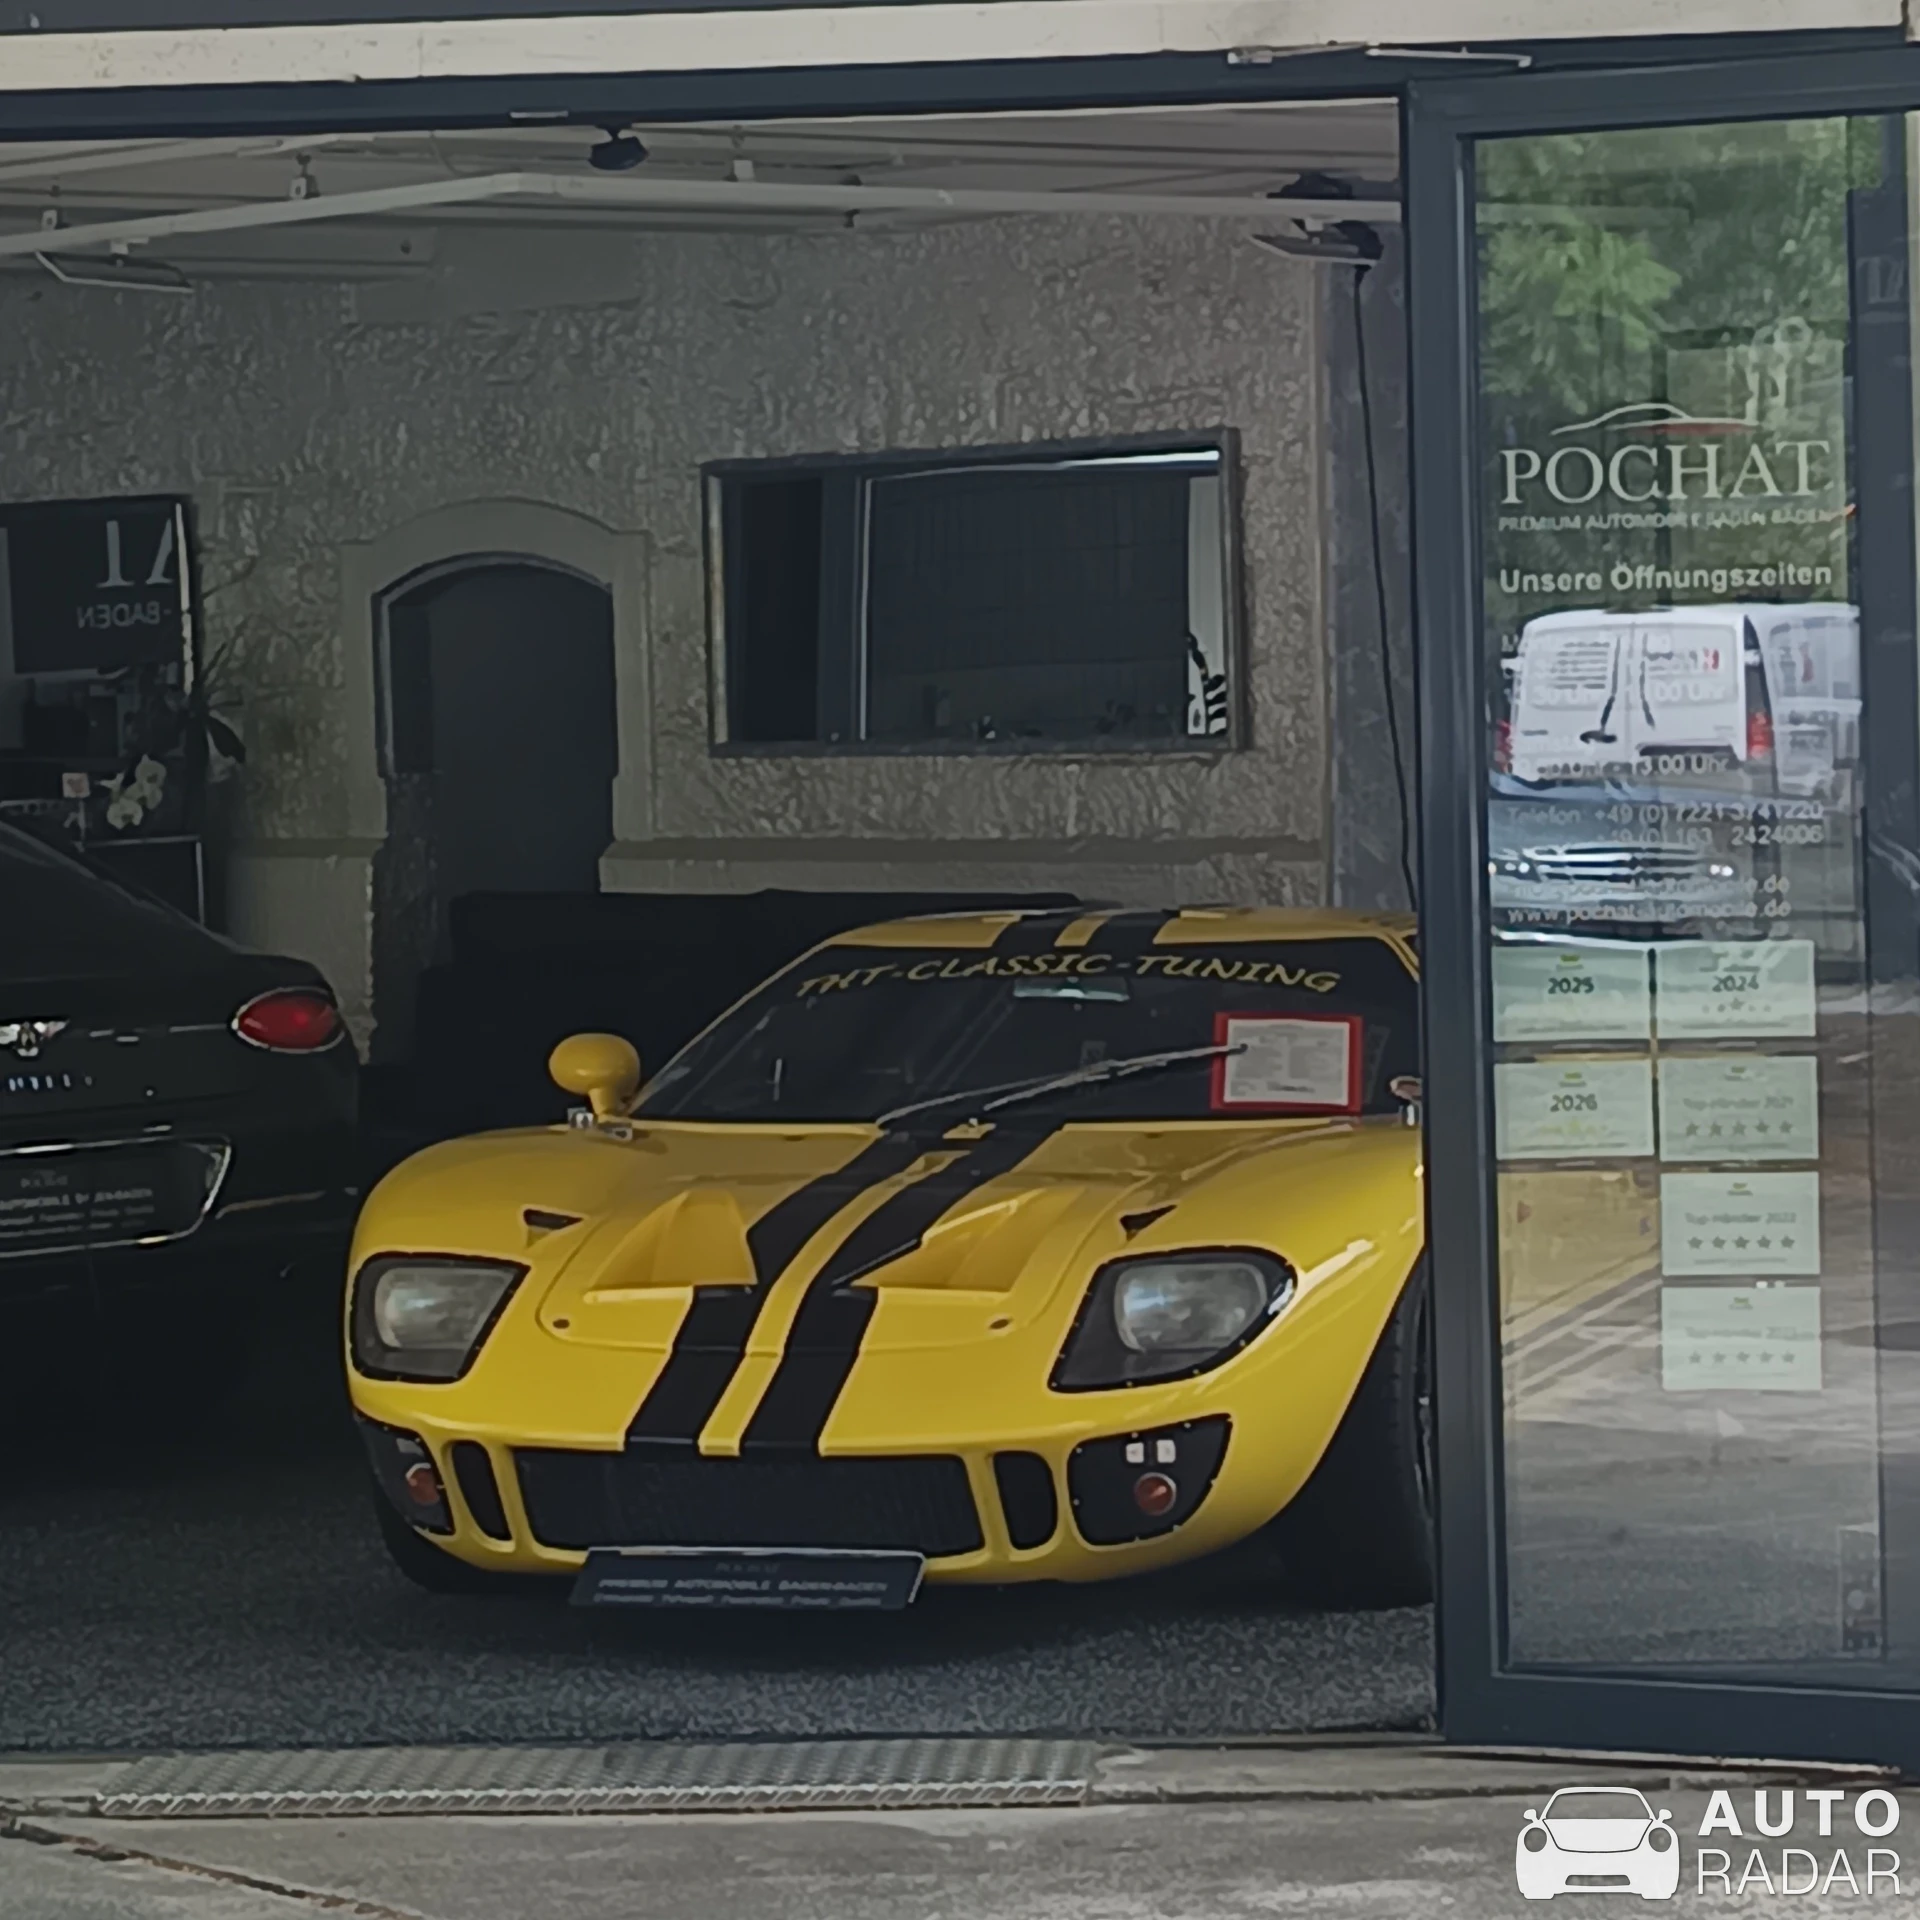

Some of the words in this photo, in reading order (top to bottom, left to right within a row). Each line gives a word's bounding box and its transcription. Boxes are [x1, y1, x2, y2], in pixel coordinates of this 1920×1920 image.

[1499, 440, 1830, 504] POCHAT
[1500, 568, 1602, 594] Unsere
[1610, 560, 1832, 594] Öffnungszeiten
[1731, 825, 1825, 845] 2424006
[1547, 975, 1595, 995] 2025
